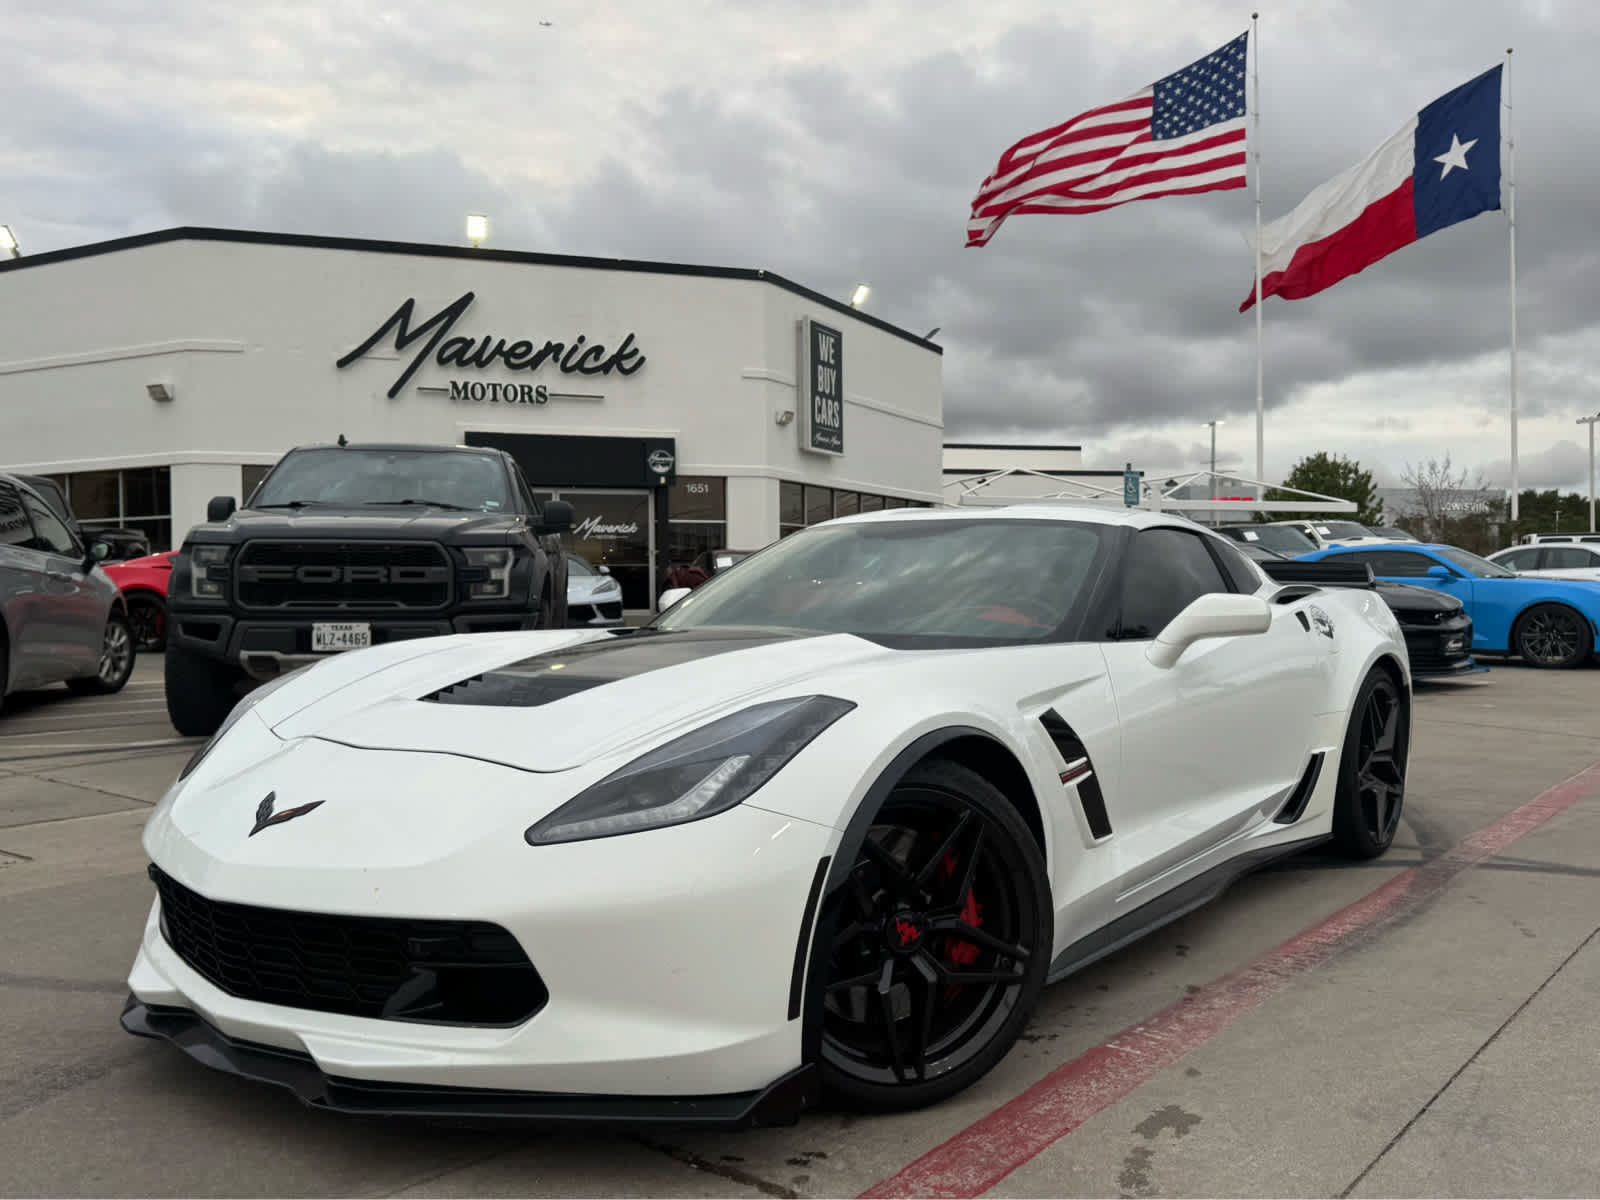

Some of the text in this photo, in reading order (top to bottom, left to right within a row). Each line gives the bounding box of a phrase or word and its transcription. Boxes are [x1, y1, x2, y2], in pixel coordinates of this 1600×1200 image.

[337, 291, 647, 399] Maverick
[818, 332, 835, 364] WE
[450, 381, 549, 405] MOTORS
[817, 365, 836, 396] BUY
[814, 396, 840, 428] CARS
[686, 483, 709, 494] 1651
[573, 515, 638, 541] Maverick
[250, 565, 437, 583] FORD
